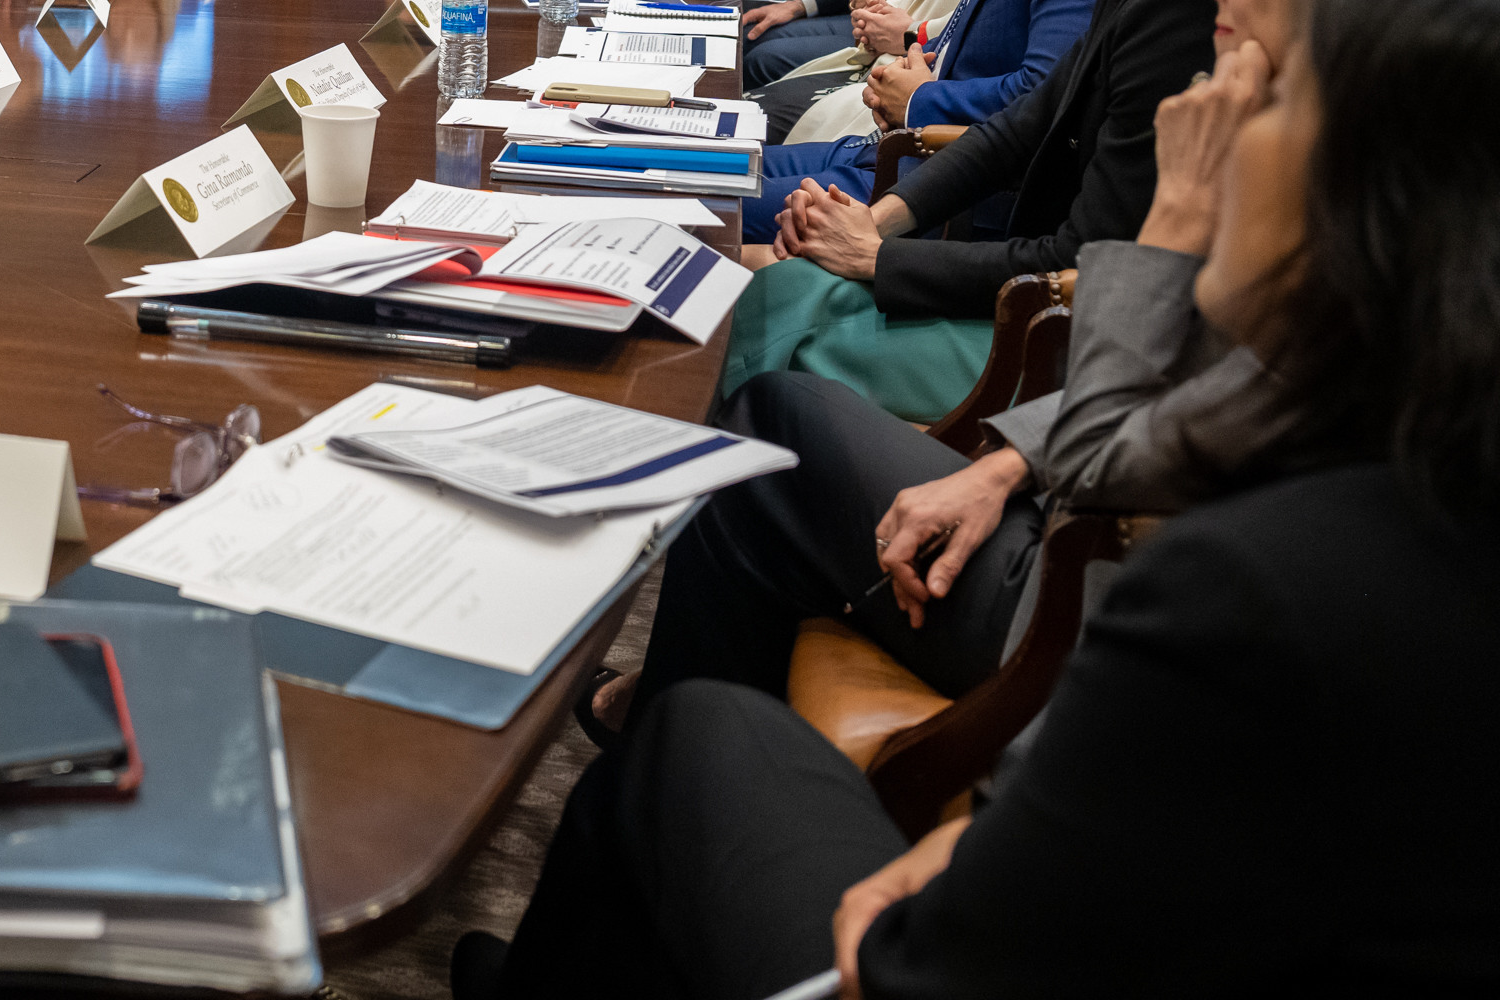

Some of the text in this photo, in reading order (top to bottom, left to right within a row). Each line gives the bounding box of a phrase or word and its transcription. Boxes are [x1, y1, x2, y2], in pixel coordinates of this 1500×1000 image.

[309, 70, 355, 97] Natalie Quillian
[196, 160, 254, 199] Gina Raimondo
[212, 194, 236, 211] Secretary
[236, 181, 260, 197] Commerce
